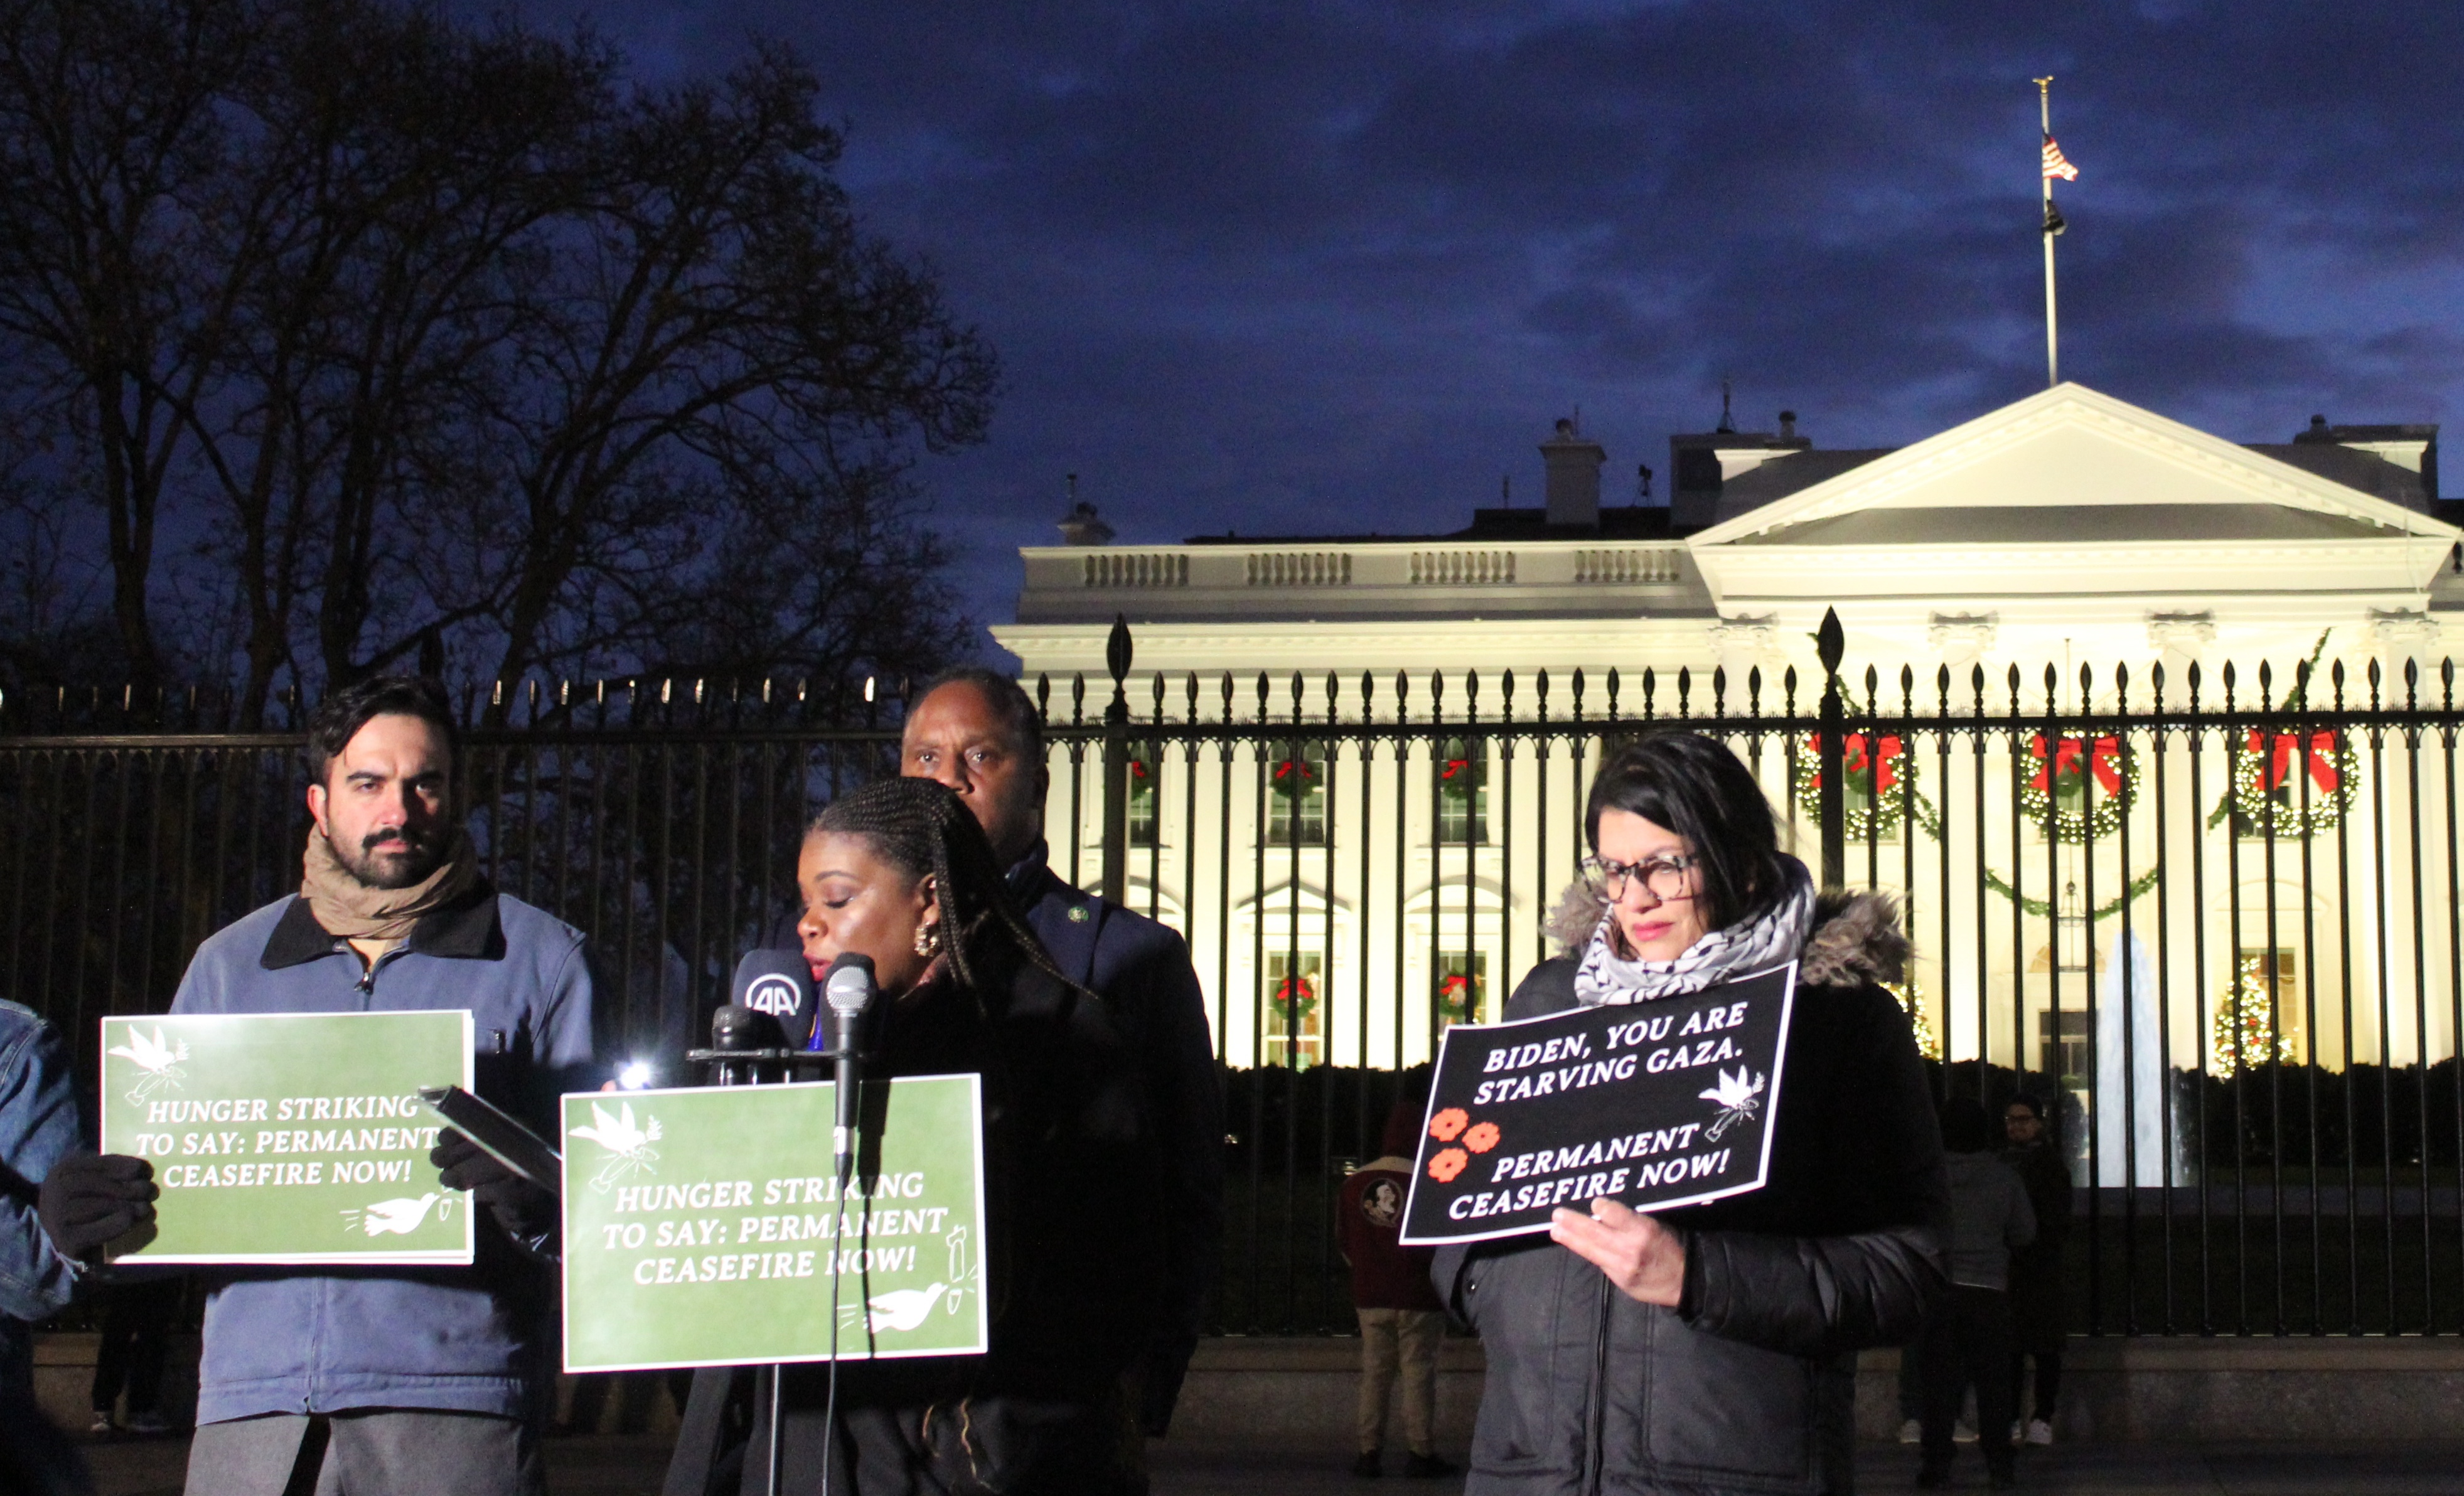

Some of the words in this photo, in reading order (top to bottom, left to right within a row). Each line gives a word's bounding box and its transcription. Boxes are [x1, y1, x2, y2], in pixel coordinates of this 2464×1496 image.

[1483, 1032, 1592, 1073] BIDEN,
[1607, 1016, 1674, 1050] YOU
[1679, 1002, 1748, 1037] ARE
[1474, 1054, 1638, 1105] STARVING
[1646, 1037, 1744, 1074] GAZA.
[146, 1098, 268, 1123] HUNGER
[277, 1096, 419, 1121] STRIKING
[136, 1133, 175, 1157] TO
[182, 1131, 245, 1155] SAY:
[255, 1127, 441, 1154] PERMANENT
[1491, 1123, 1700, 1183] PERMANENT
[163, 1162, 323, 1188] CEASEFIRE
[331, 1160, 412, 1184] NOW!
[1449, 1169, 1629, 1221] CEASEFIRE
[1637, 1148, 1731, 1189] NOW!
[614, 1180, 753, 1212] HUNGER
[603, 1223, 645, 1249] TO
[655, 1219, 727, 1246] SAY:
[737, 1207, 949, 1244] PERMANENT
[633, 1250, 815, 1285] CEASEFIRE
[824, 1246, 916, 1276] NOW!
